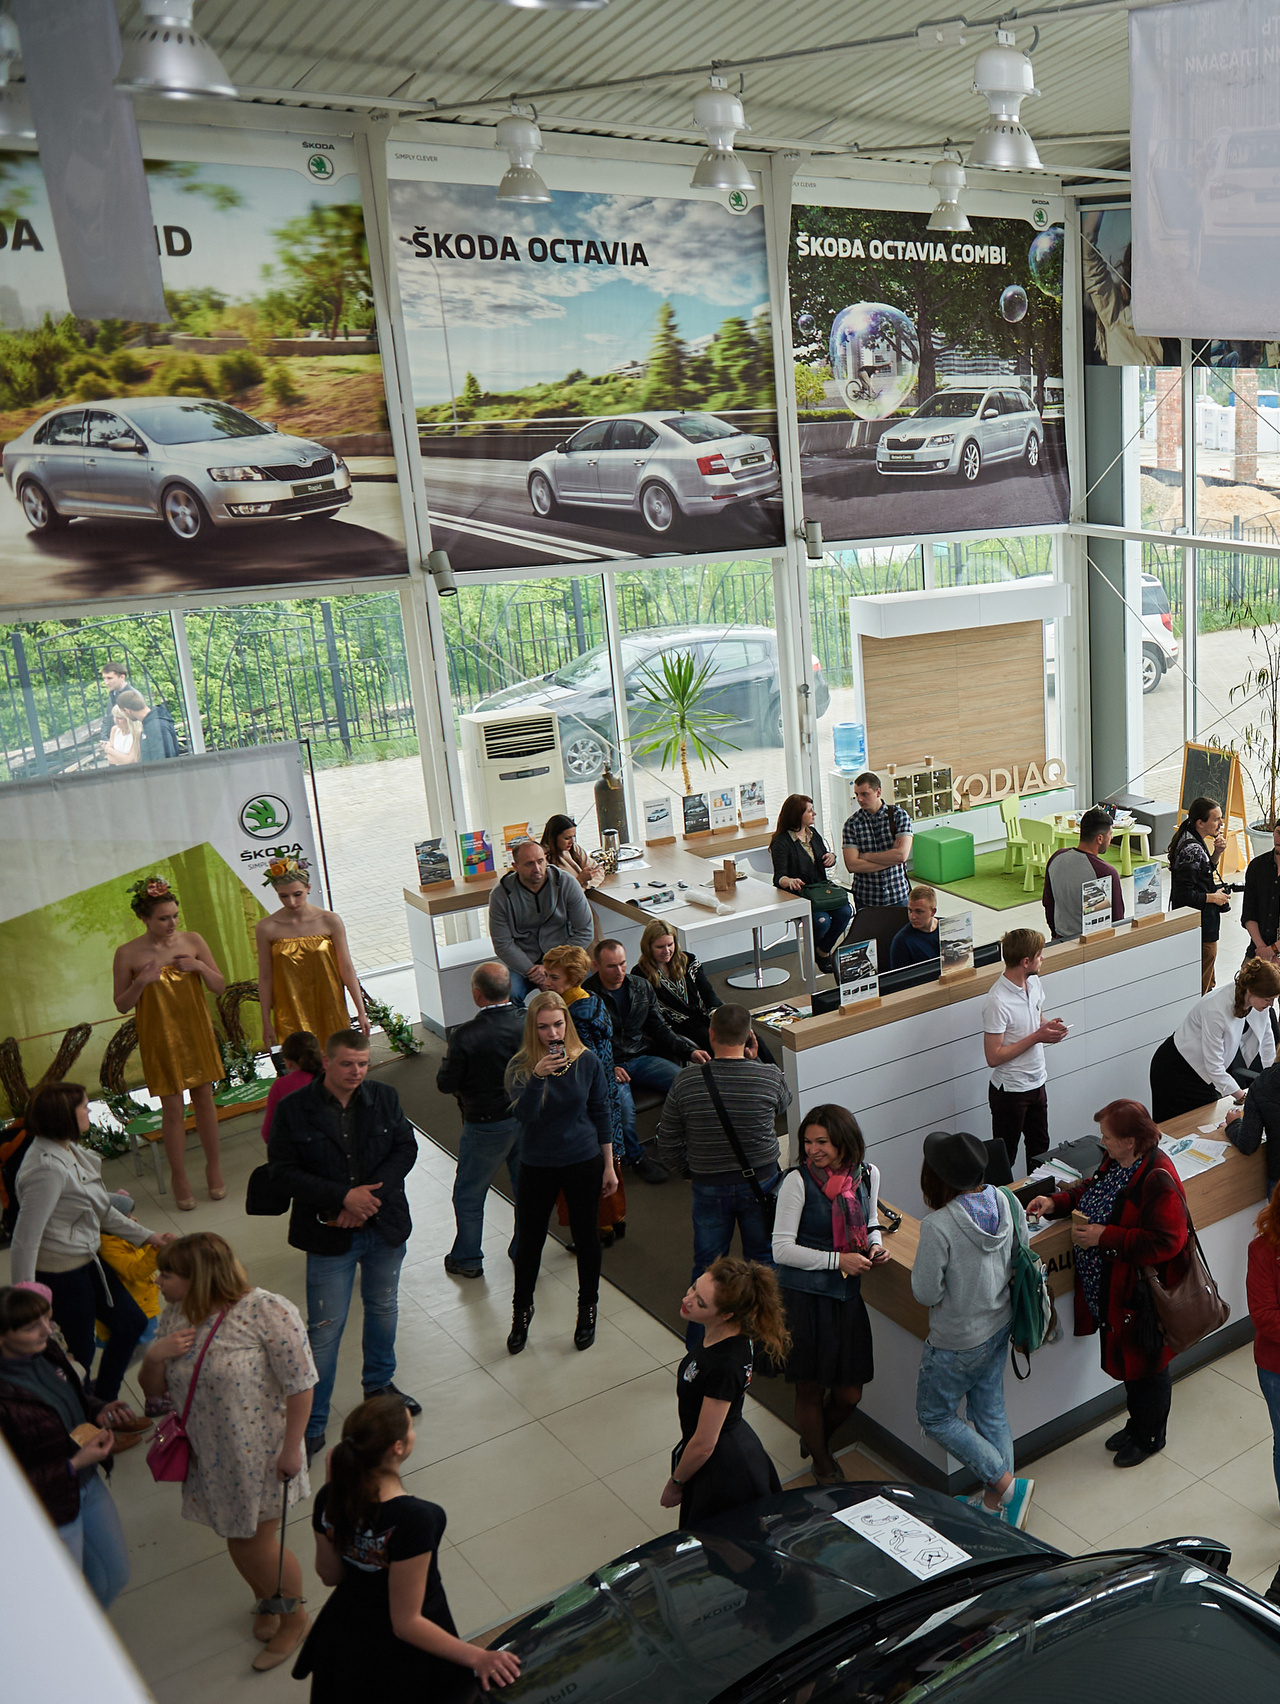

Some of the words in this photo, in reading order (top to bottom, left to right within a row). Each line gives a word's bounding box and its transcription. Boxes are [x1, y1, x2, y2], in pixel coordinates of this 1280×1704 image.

[301, 141, 335, 151] ŠKODA
[416, 154, 438, 162] CLEVER
[412, 226, 521, 261] ŠKODA
[528, 237, 650, 267] OCTAVIA
[796, 232, 866, 259] ŠKODA
[869, 240, 948, 263] OCTAVIA
[951, 243, 1007, 265] COMBI
[952, 757, 1068, 805] KODIAQ
[240, 843, 304, 862] ŠKODA
